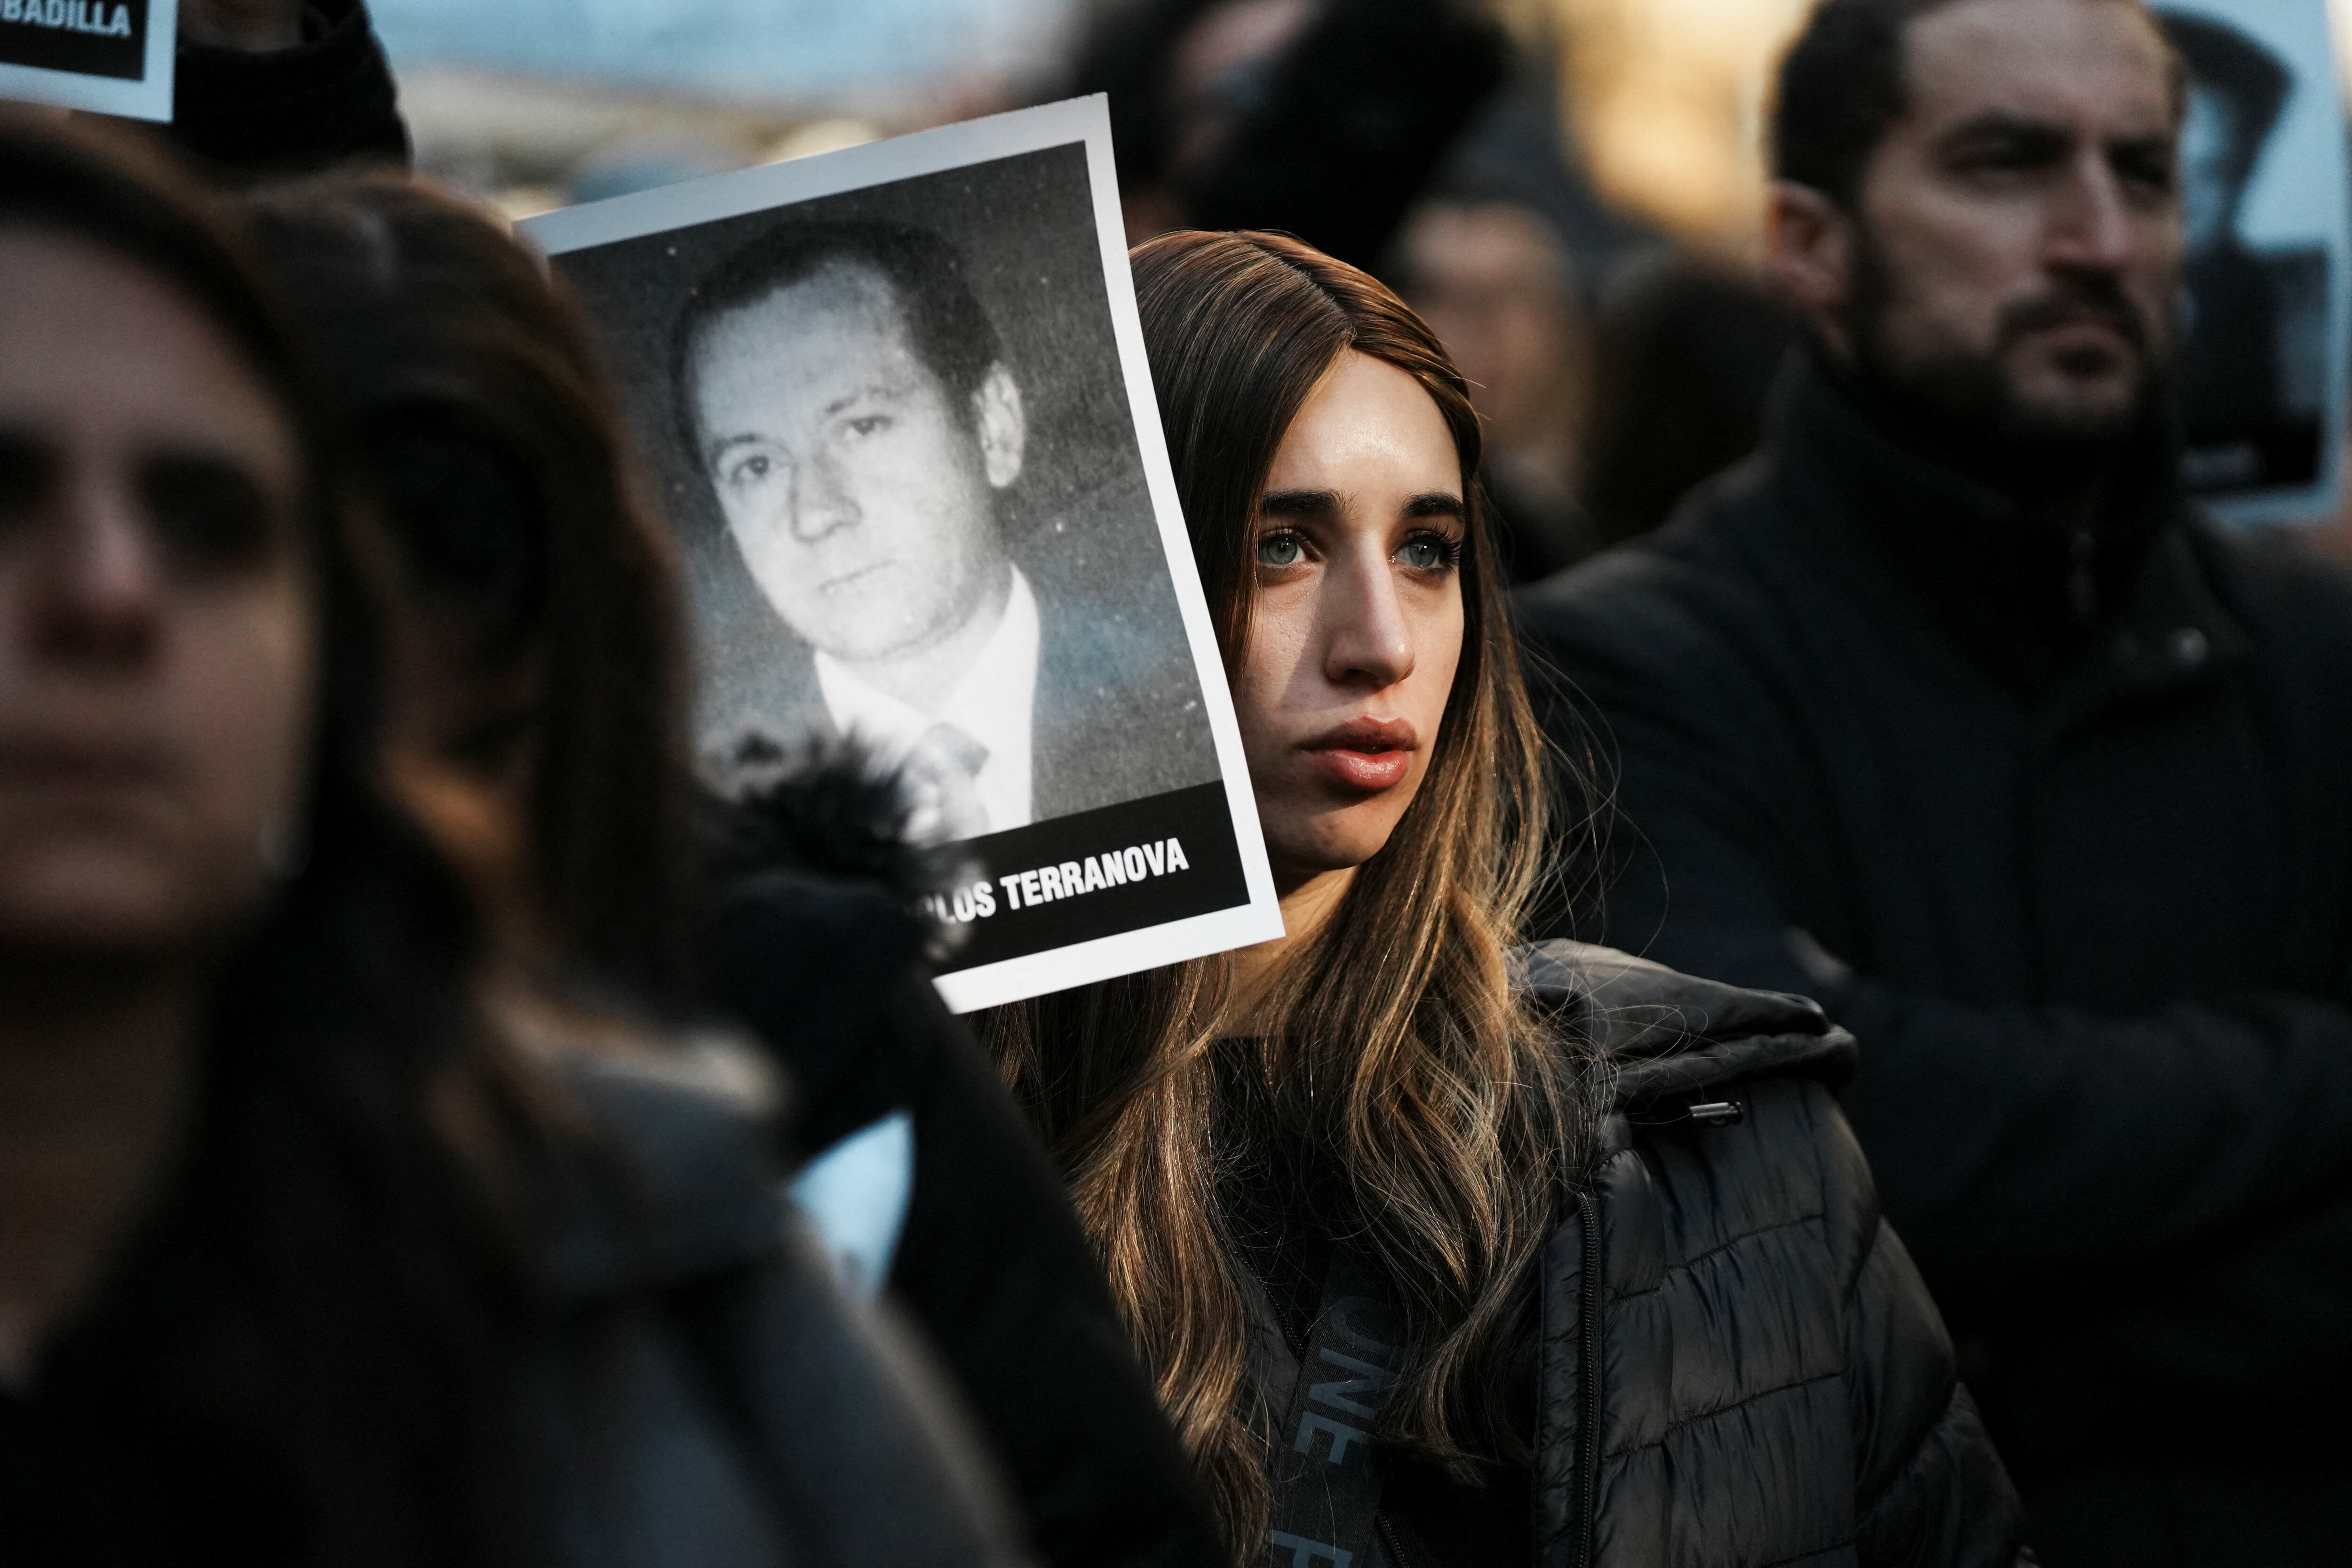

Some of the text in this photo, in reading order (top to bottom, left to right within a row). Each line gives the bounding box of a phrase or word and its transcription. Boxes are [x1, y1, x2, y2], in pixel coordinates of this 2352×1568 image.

[0, 0, 132, 38] BADILLA
[923, 837, 1189, 925] LOS TERRANOVA
